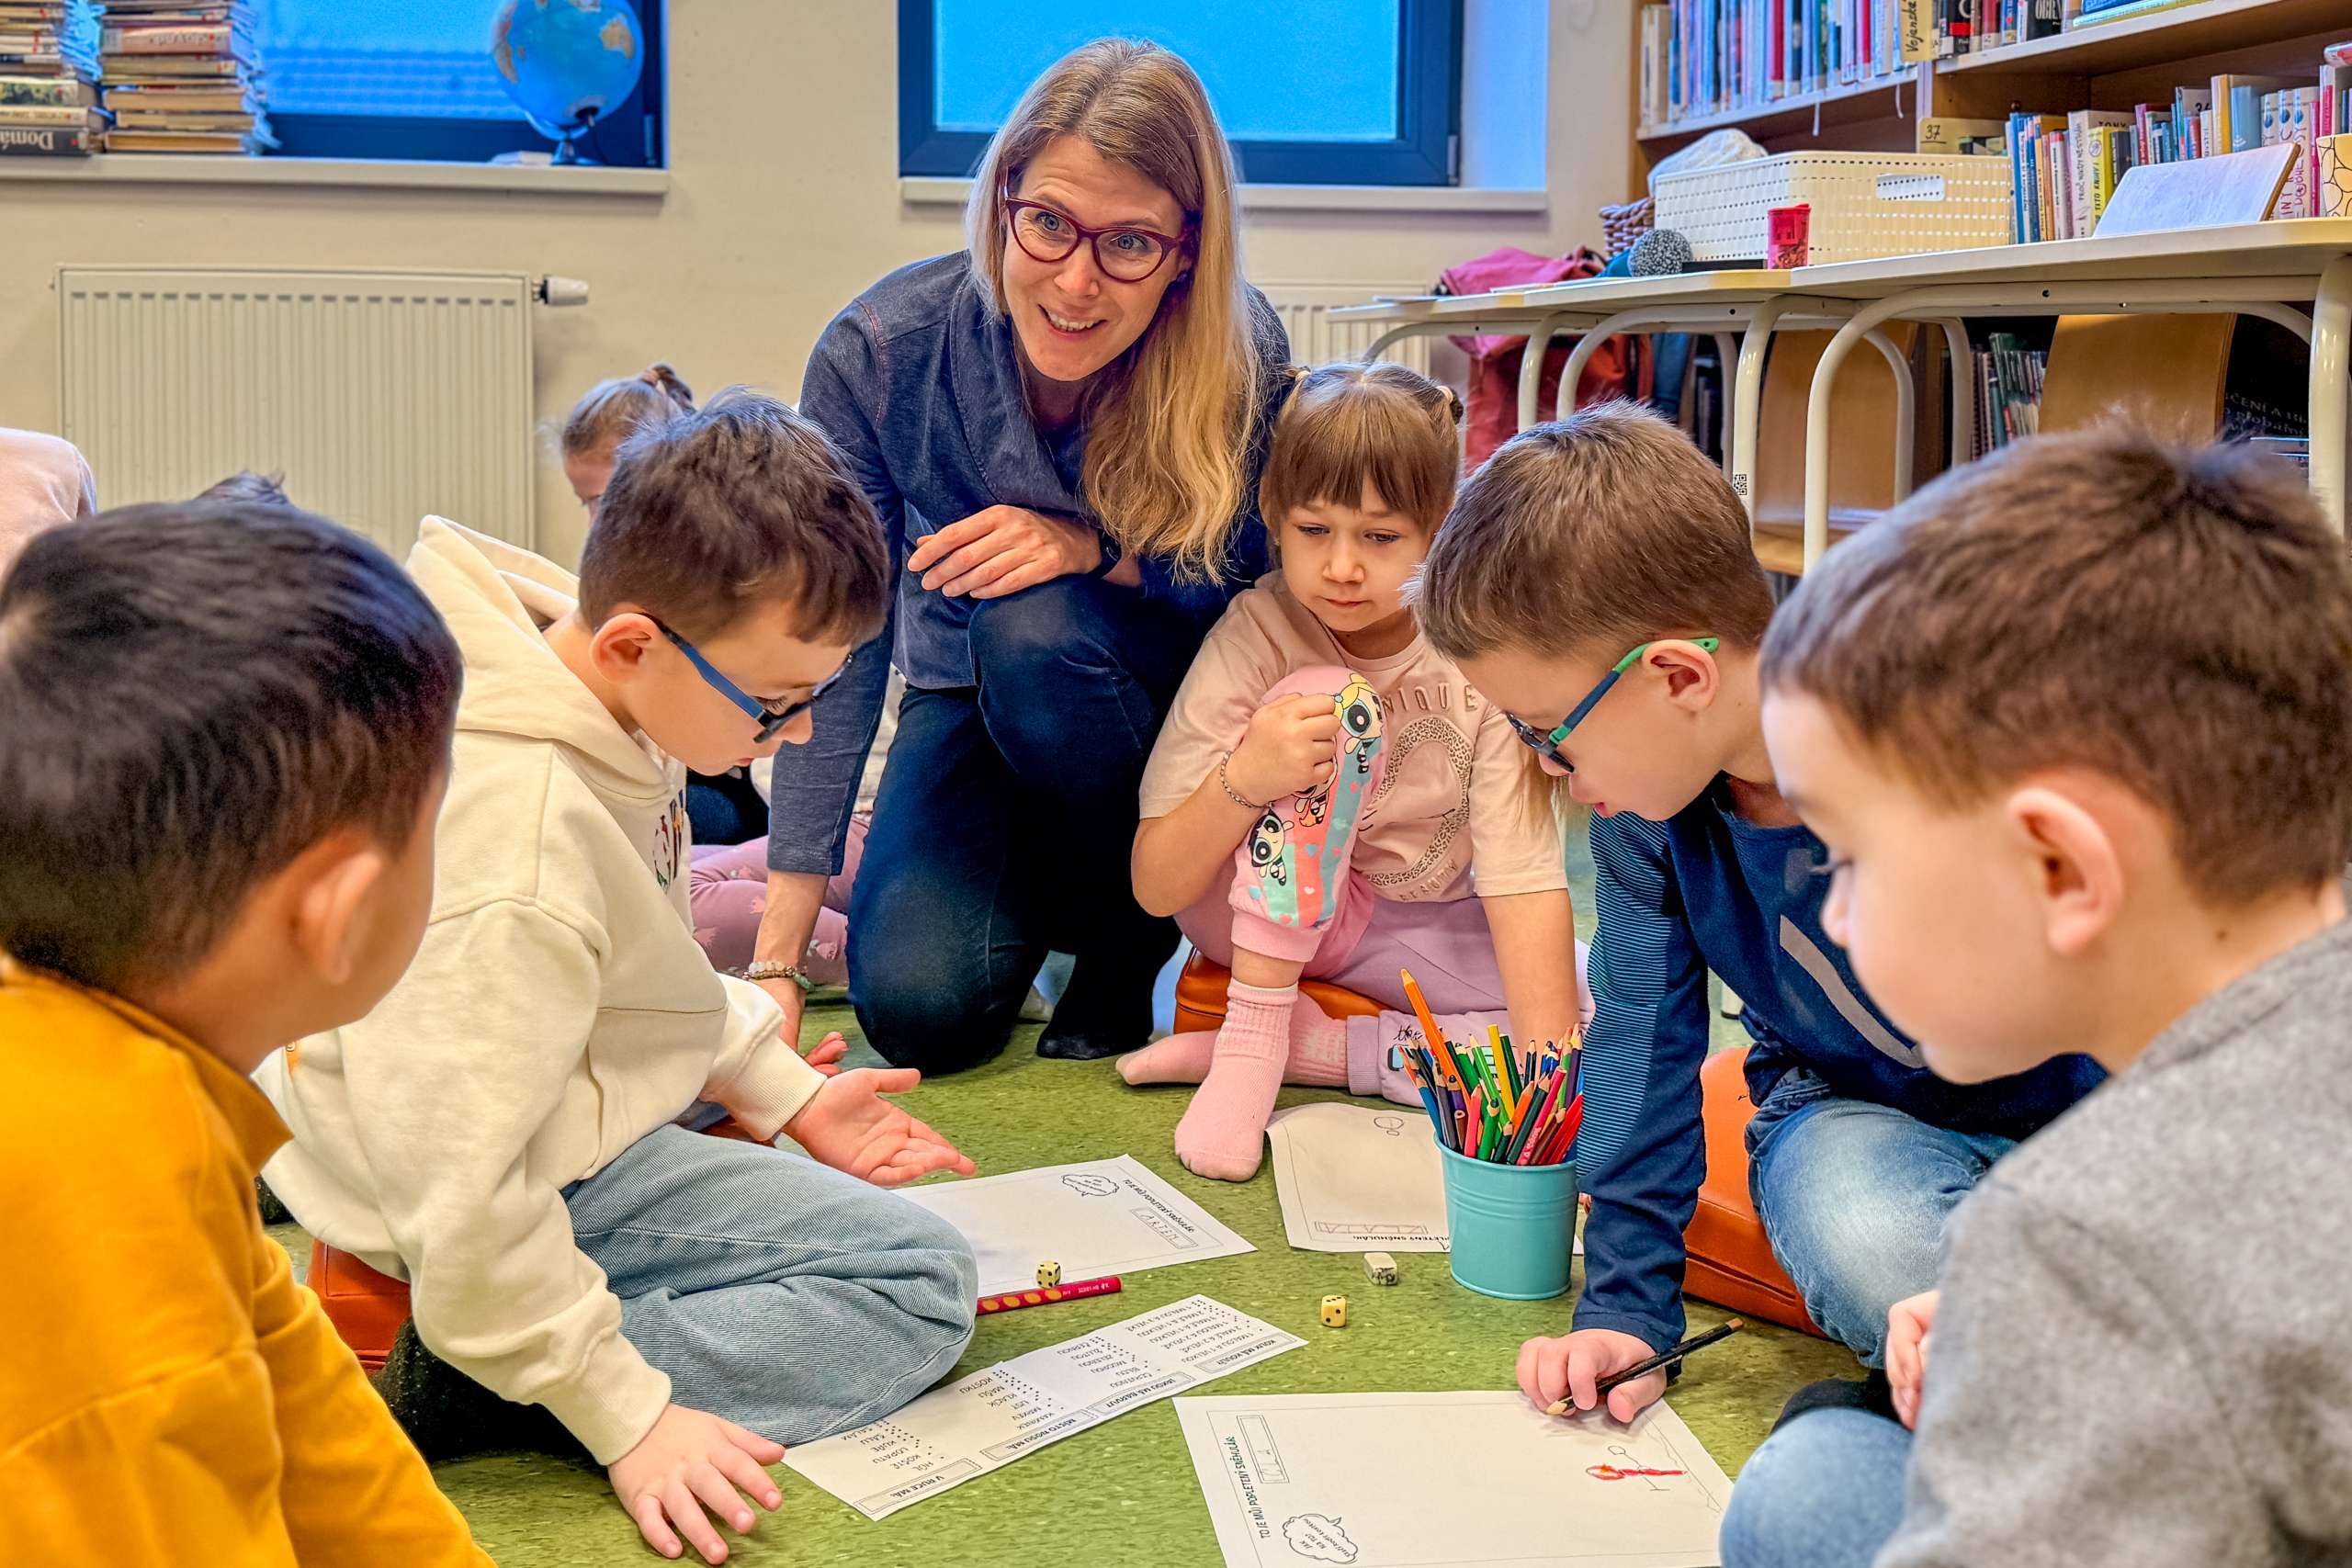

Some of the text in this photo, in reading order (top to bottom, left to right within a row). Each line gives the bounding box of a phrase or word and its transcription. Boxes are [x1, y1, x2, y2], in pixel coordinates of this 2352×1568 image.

[1924, 125, 1942, 140] 37
[1381, 682, 1478, 716] NIQUE
[959, 1377, 993, 1394] KOSTKU
[872, 1447, 909, 1464] LOPATU
[910, 1478, 936, 1491] RUCE
[1238, 1471, 1258, 1506] POPLETENÝ
[1260, 1529, 1271, 1540] TO
